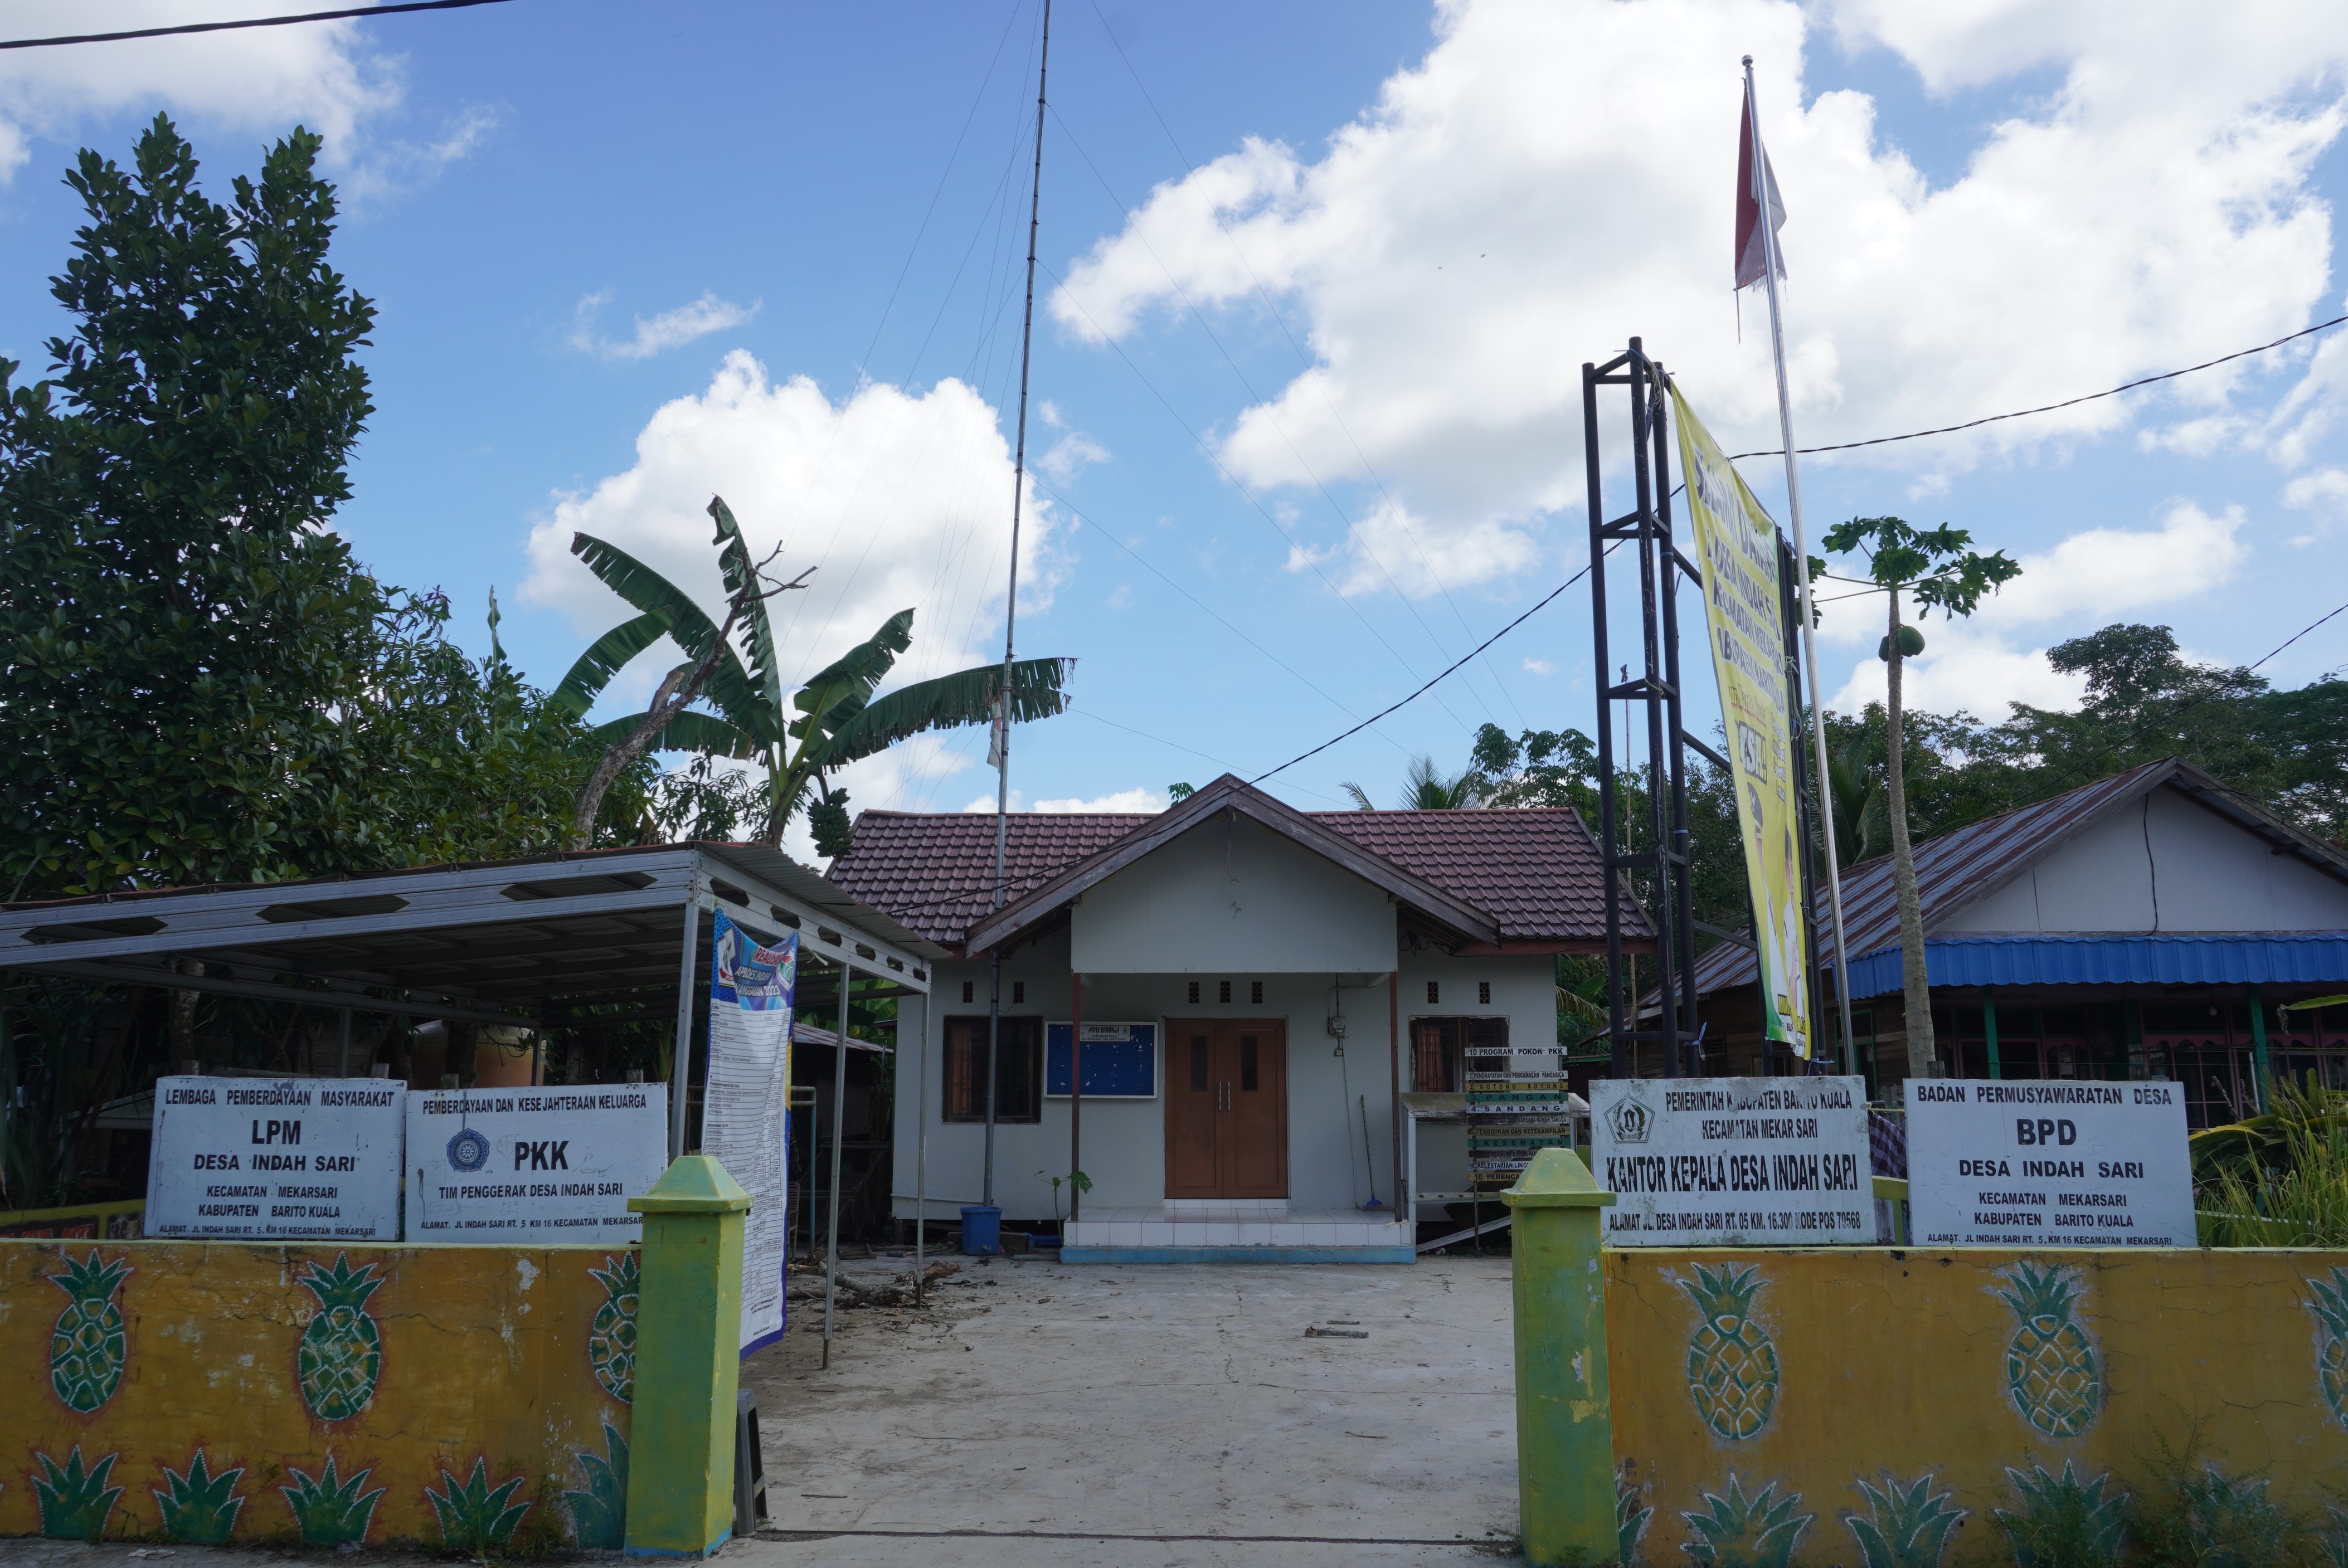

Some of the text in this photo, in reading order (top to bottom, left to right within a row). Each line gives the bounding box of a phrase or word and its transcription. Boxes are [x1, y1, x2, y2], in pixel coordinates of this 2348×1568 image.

[734, 965, 757, 980] APBDES
[764, 985, 780, 996] 2023
[166, 1088, 395, 1107] LEMBAGA PEMBERDAYAAN MASYARAKAT
[423, 1094, 646, 1114] PEMBERDAYAAN DAN KESEJAHTERAAN KELUARGA
[1665, 1091, 1724, 1112] PEMERINTAH
[1918, 1085, 2172, 1105] BADAN PERMUSYAWARATAN DESA
[251, 1119, 301, 1145] LPM
[1761, 1118, 1795, 1139] MEKAR
[1796, 1118, 1818, 1138] SARI
[2016, 1118, 2077, 1146] BPD
[193, 1154, 355, 1172] DESA INDAH SARI
[514, 1141, 569, 1171] PKK
[1606, 1153, 1858, 1193] KANTOR KEPALA DESA INDAH SARI
[1959, 1160, 2143, 1179] DESA INDAH SARI
[206, 1185, 338, 1199] KECAMATAN MEKARSARI
[439, 1182, 623, 1199] TIM PENGGERAK DESA INDAH SARI
[1978, 1192, 2127, 1207] KECAMATAN MEKARSARI
[198, 1204, 341, 1218] KABUPATEN BARITO KUALA
[1974, 1212, 2134, 1227] KABUPATEN BARITO KUALA
[421, 1219, 450, 1229] ALAMAT.
[465, 1220, 487, 1229] INDAH
[488, 1220, 505, 1229] SARI
[507, 1220, 517, 1228] RT.
[543, 1219, 552, 1228] 16
[553, 1218, 598, 1227] KECAMATAN
[1610, 1215, 1640, 1231] ALAMAT
[1656, 1212, 1677, 1231] DESA
[1678, 1212, 1703, 1230] INDAH
[1704, 1212, 1723, 1230] SARI
[1725, 1212, 1737, 1229] RT.
[1739, 1212, 1749, 1230] 05
[1750, 1212, 1766, 1230] KM.
[1818, 1211, 1835, 1230] POS
[160, 1225, 188, 1234] ALAMAT.
[191, 1225, 201, 1234] JL
[202, 1225, 223, 1234] INDAH
[242, 1226, 254, 1234] RT.
[265, 1225, 277, 1234] KM
[288, 1226, 330, 1235] KECAMATAN
[336, 1228, 376, 1236] MEKARSARI
[1927, 1234, 1961, 1244] ALAMAT.
[1965, 1234, 1974, 1243] JL
[1976, 1234, 2000, 1243] INDAH
[2002, 1235, 2020, 1243] SARI
[2023, 1235, 2034, 1244] RT.
[2048, 1235, 2060, 1244] KM
[2063, 1235, 2072, 1244] 16
[2074, 1236, 2122, 1245] KECAMATAN
[2126, 1236, 2172, 1245] MEKARSARI
